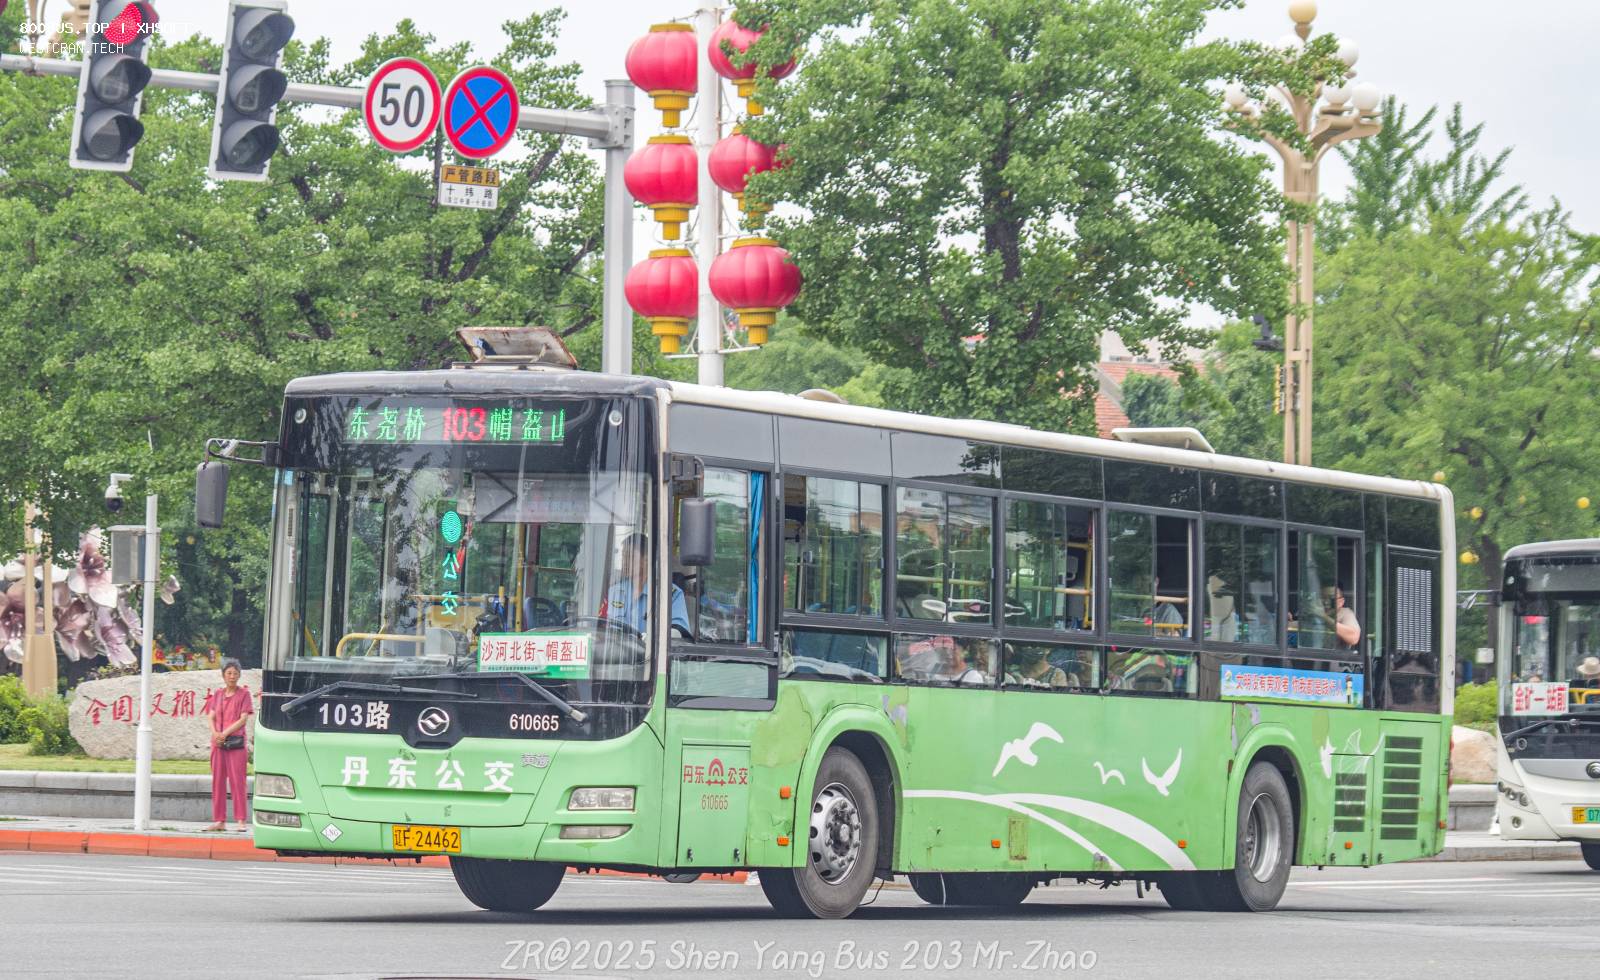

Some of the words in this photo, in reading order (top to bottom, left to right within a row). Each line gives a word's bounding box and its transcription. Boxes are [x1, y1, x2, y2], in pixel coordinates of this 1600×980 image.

[379, 83, 425, 127] 50
[444, 167, 497, 185] 严管路段
[347, 406, 427, 441] 东尧桥
[442, 406, 487, 441] 103
[489, 407, 566, 442] 帽盔山
[441, 552, 460, 616] 公交
[481, 640, 587, 662] 沙河北街-帽盔山
[319, 702, 391, 730] 103路
[509, 713, 560, 732] 610665
[340, 756, 515, 793] 丹东公交
[683, 765, 705, 784] 丹东
[728, 767, 748, 785] 公交
[701, 794, 729, 810] 610665
